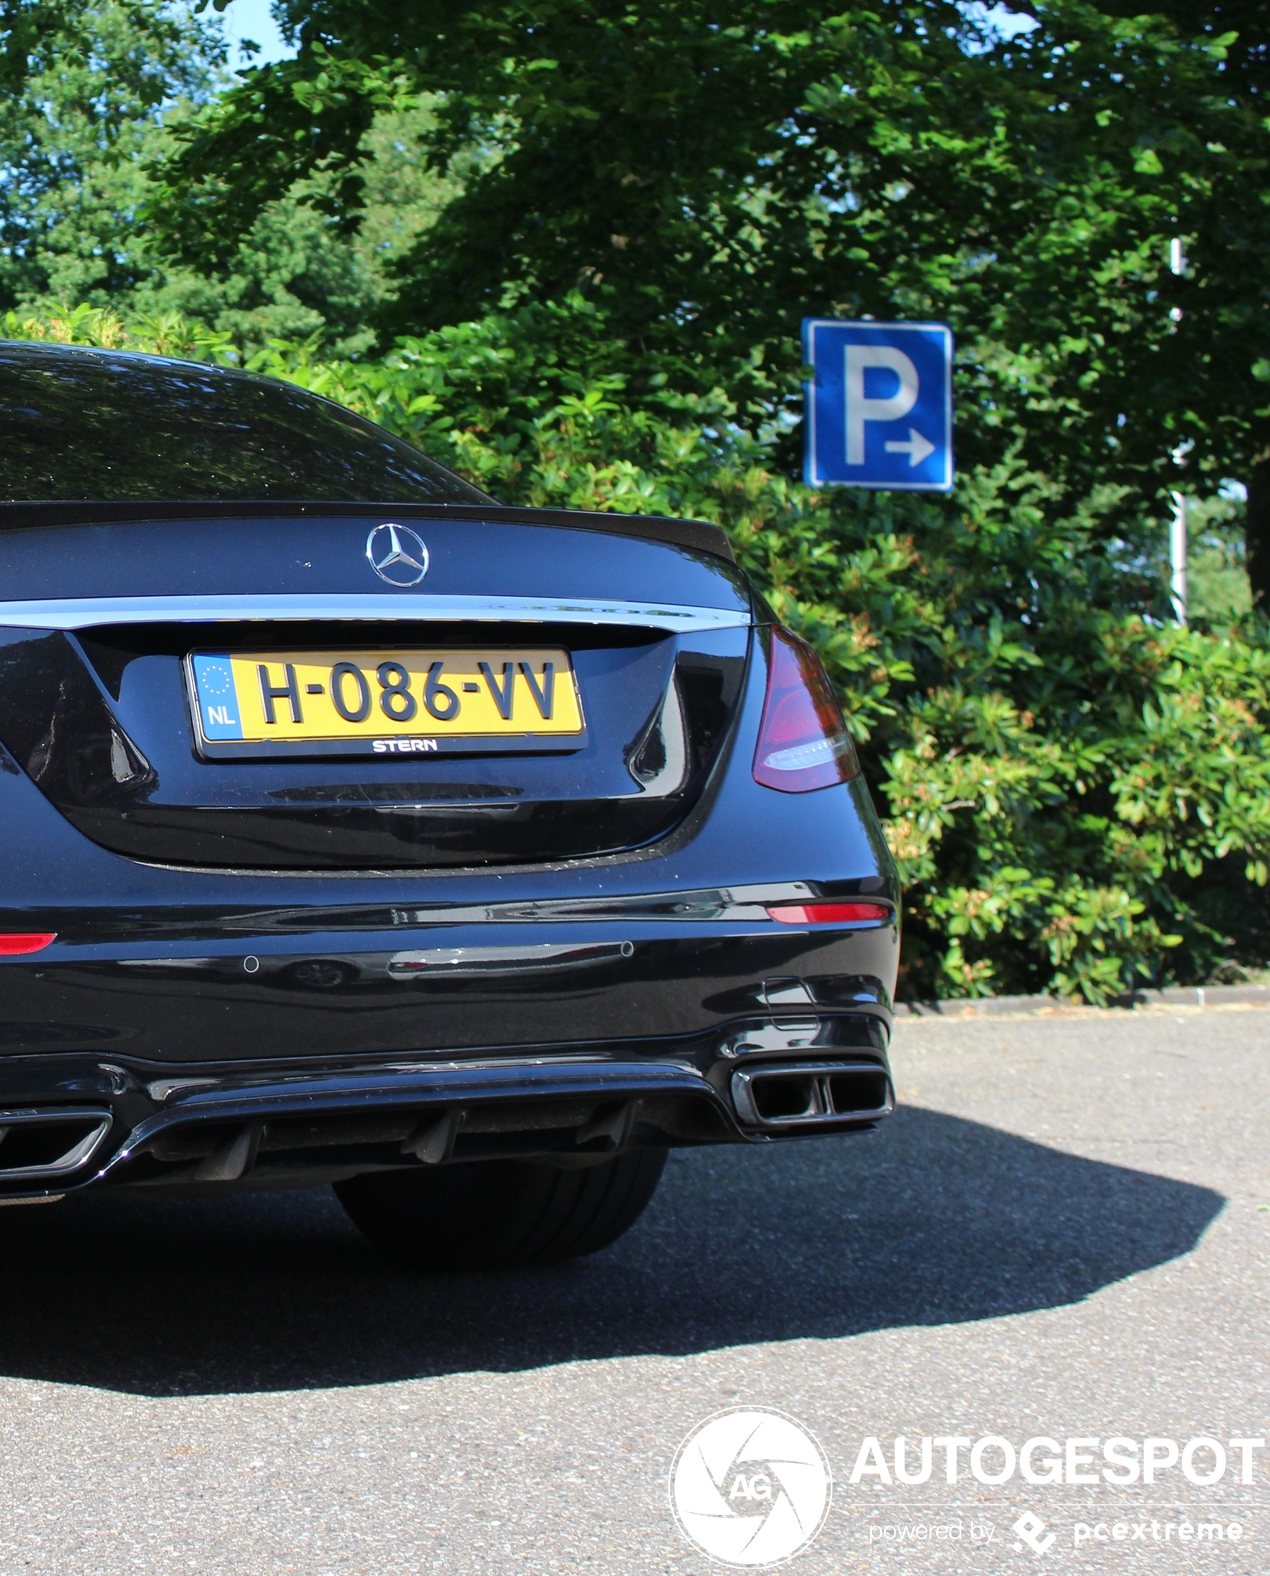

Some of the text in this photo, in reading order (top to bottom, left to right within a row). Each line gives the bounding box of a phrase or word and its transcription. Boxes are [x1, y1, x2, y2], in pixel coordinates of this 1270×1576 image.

[844, 344, 919, 465] P
[256, 660, 555, 725] H-086-VV
[208, 706, 235, 725] NL
[372, 739, 438, 753] STERN
